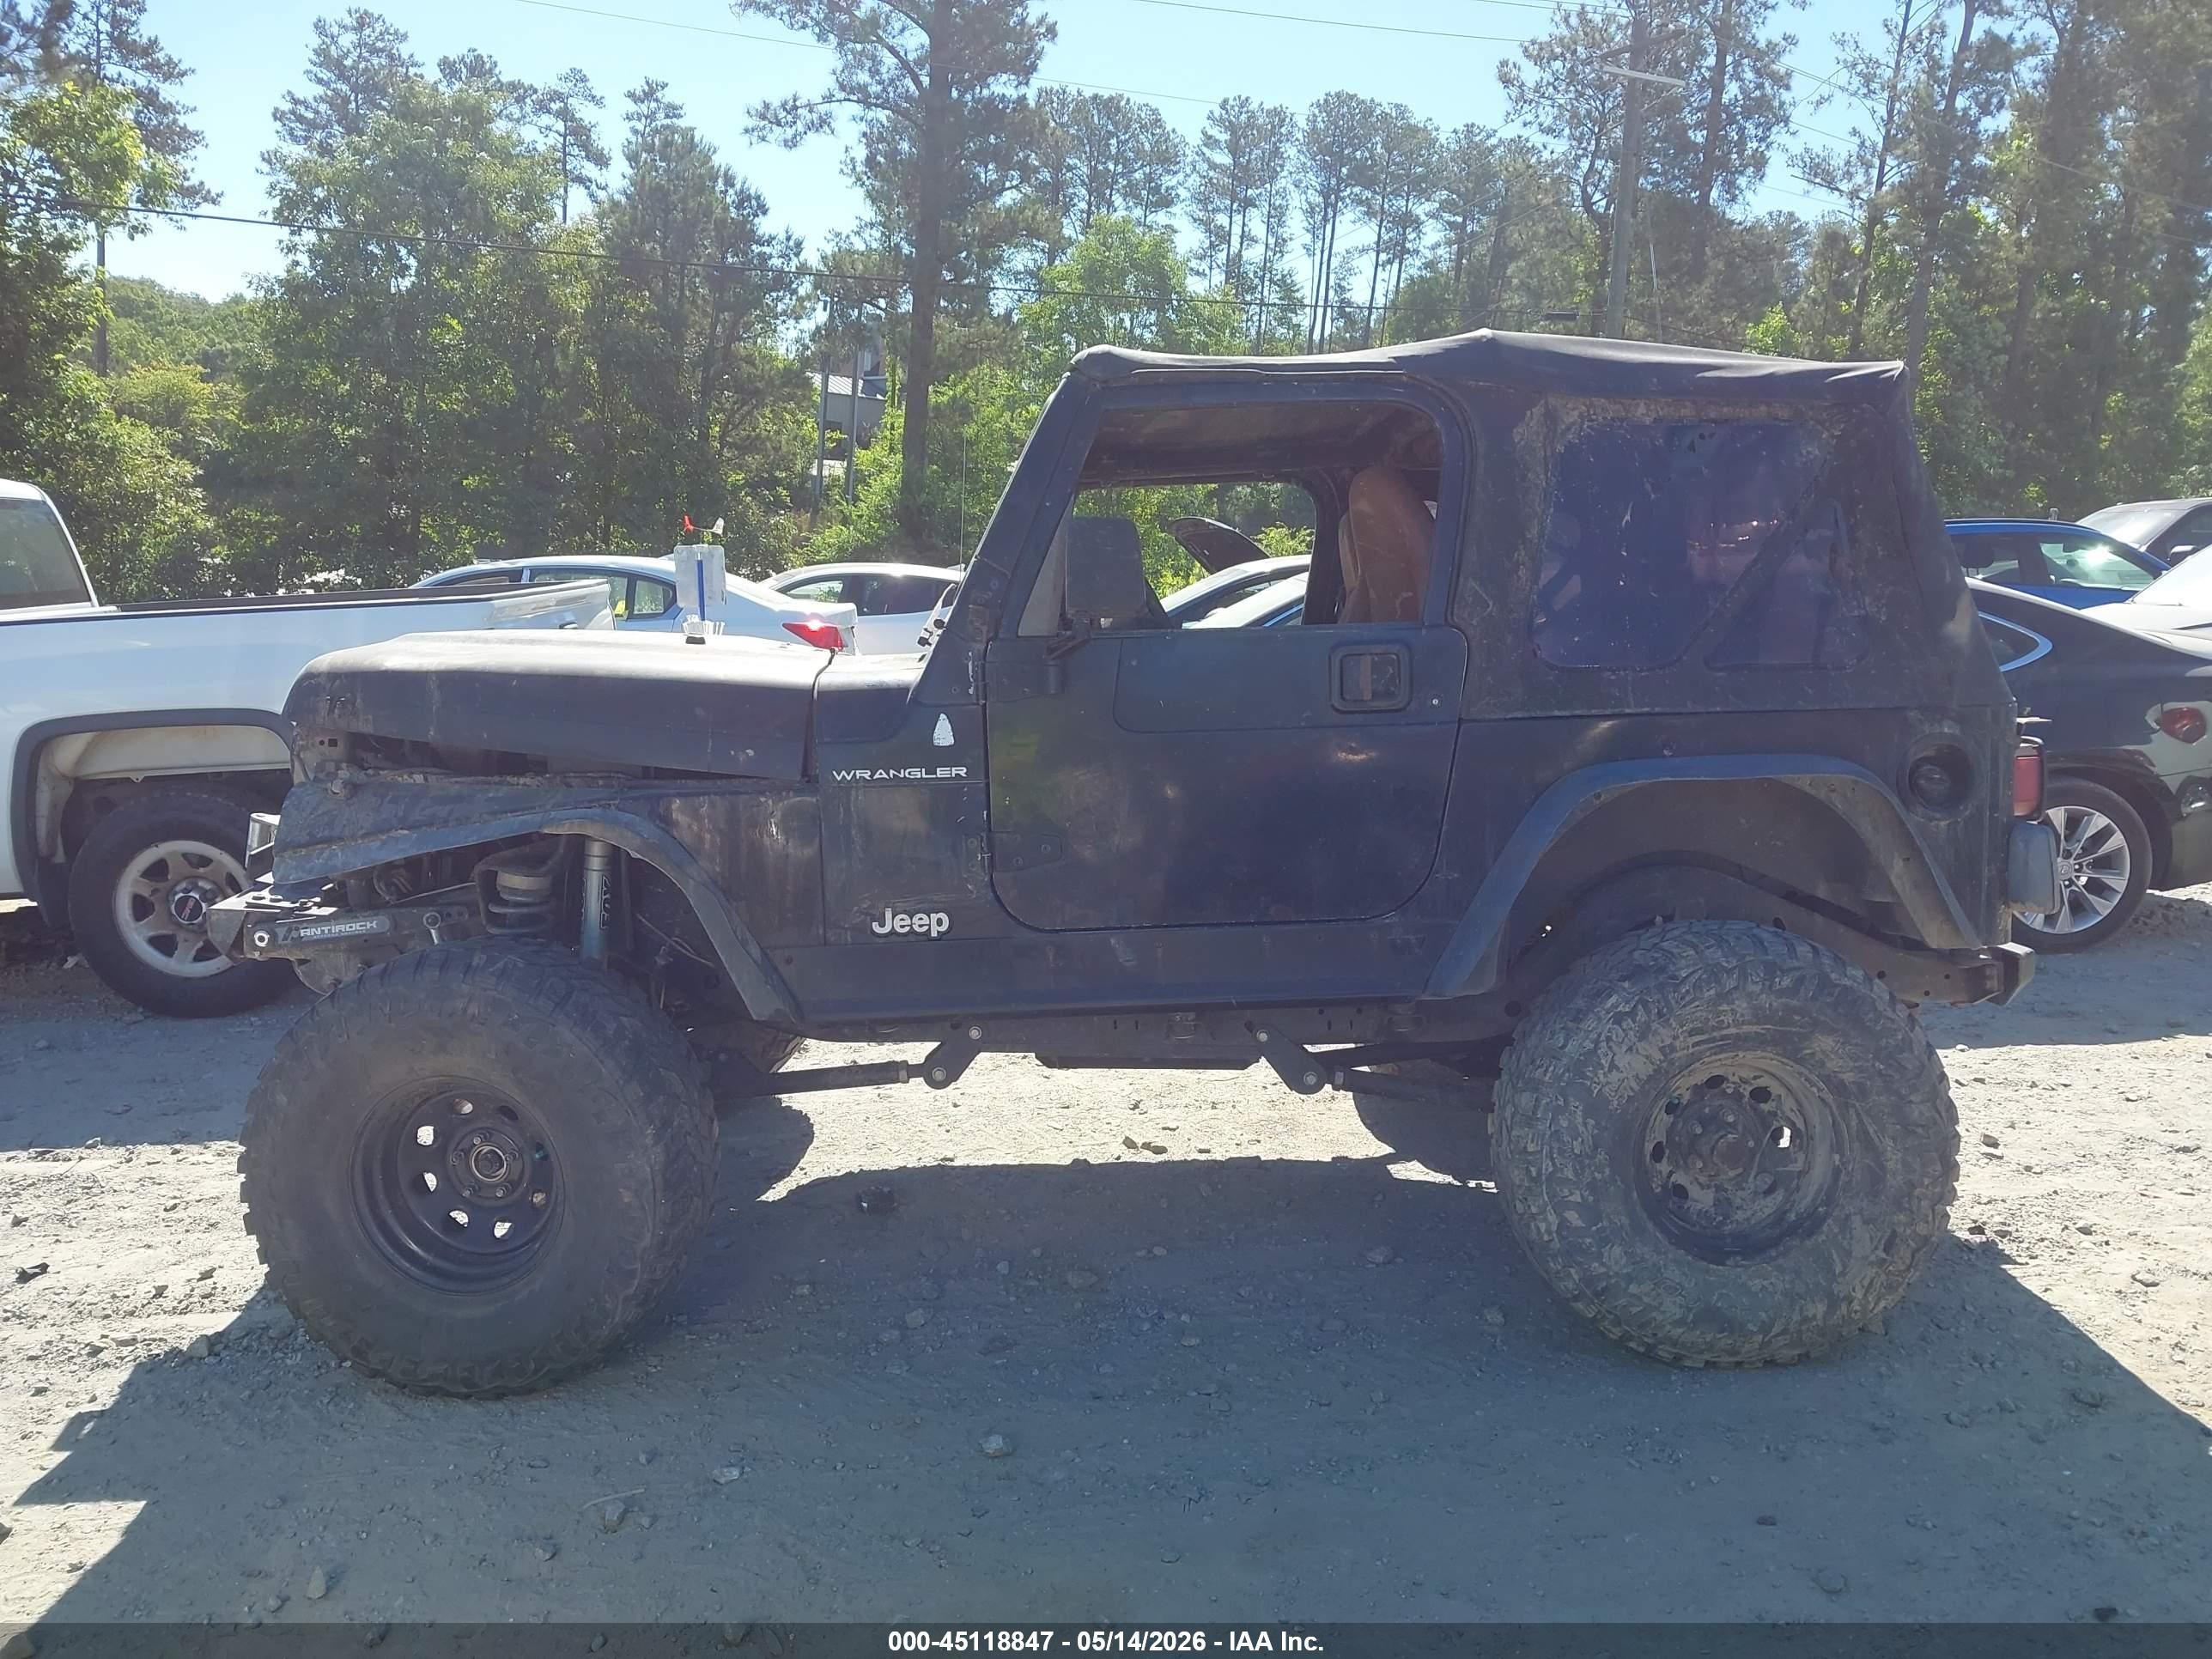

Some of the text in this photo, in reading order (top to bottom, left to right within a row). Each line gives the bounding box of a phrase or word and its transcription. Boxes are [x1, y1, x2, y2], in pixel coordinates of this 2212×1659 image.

[831, 766, 968, 781] WRANGLER
[300, 920, 378, 937] ANTIROCK
[872, 907, 950, 938] Jeep
